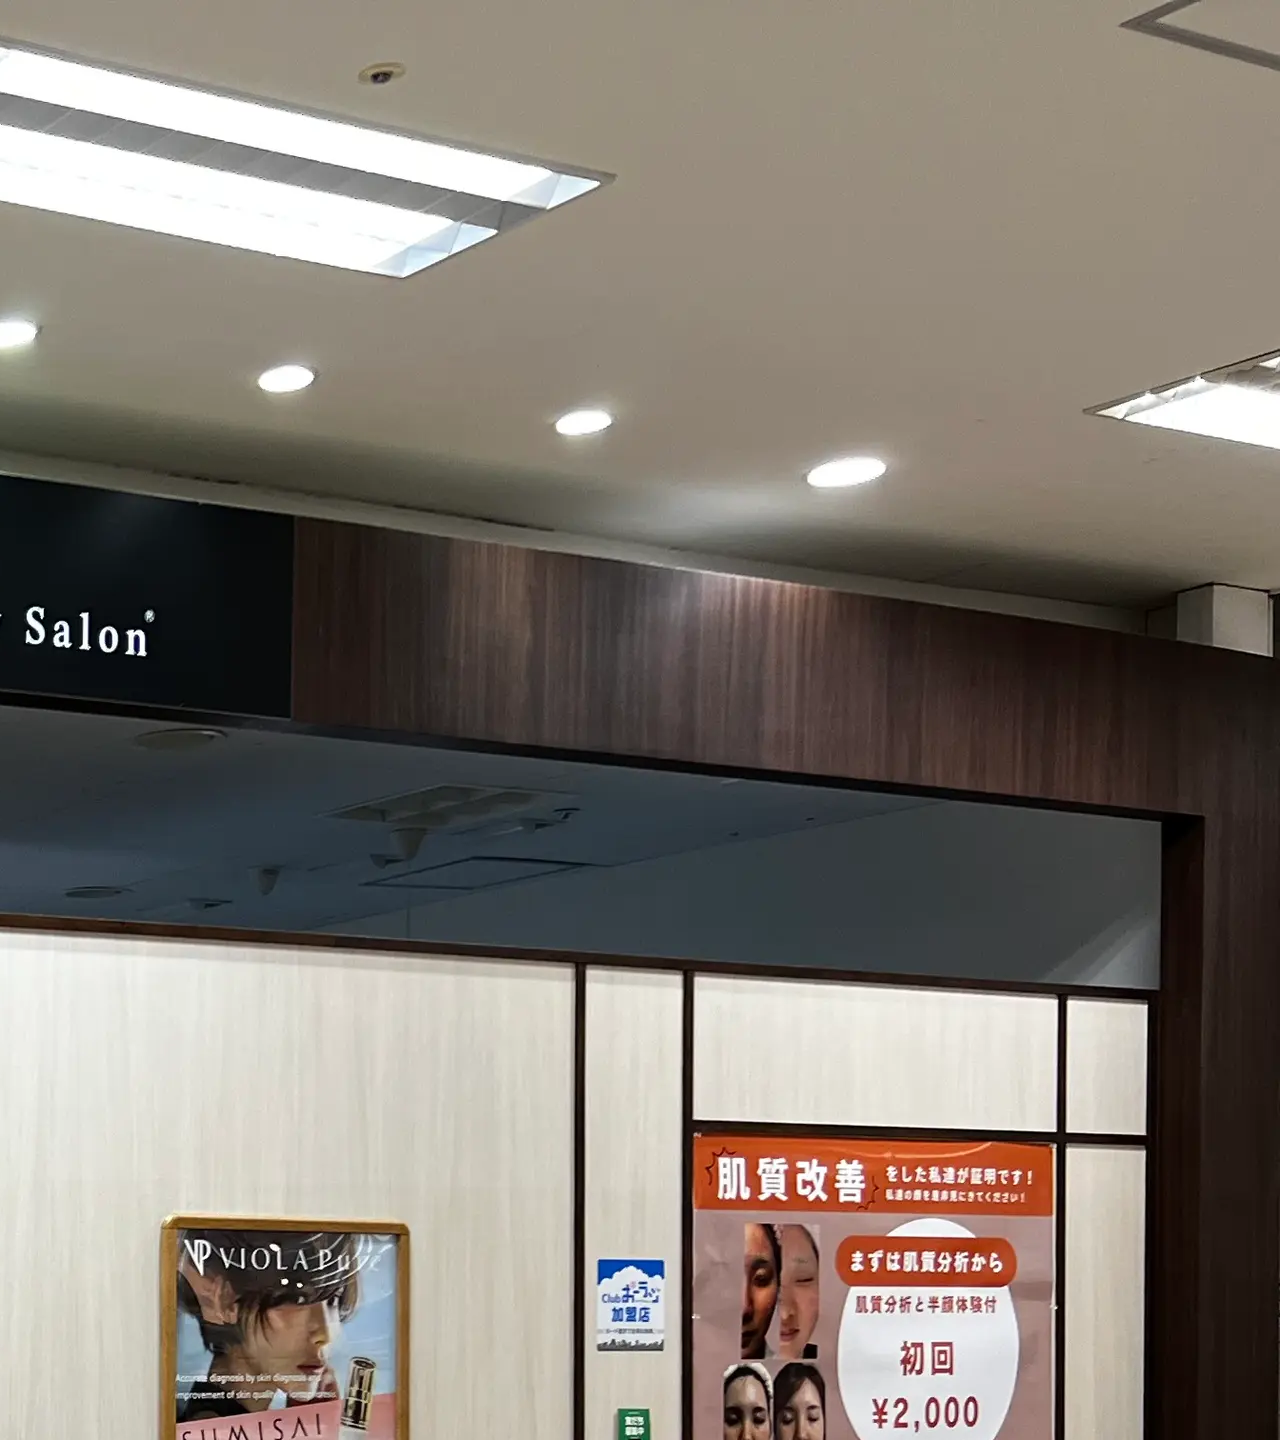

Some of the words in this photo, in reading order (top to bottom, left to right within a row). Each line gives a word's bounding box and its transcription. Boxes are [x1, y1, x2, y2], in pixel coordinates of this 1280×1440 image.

[717, 1156, 866, 1203] 肌質改善
[220, 1247, 308, 1271] VIOLA
[850, 1250, 1003, 1273] まずは肌質分析から
[612, 1306, 650, 1322] 加盟店
[900, 1340, 954, 1376] 初回
[872, 1396, 979, 1433] ¥2,000
